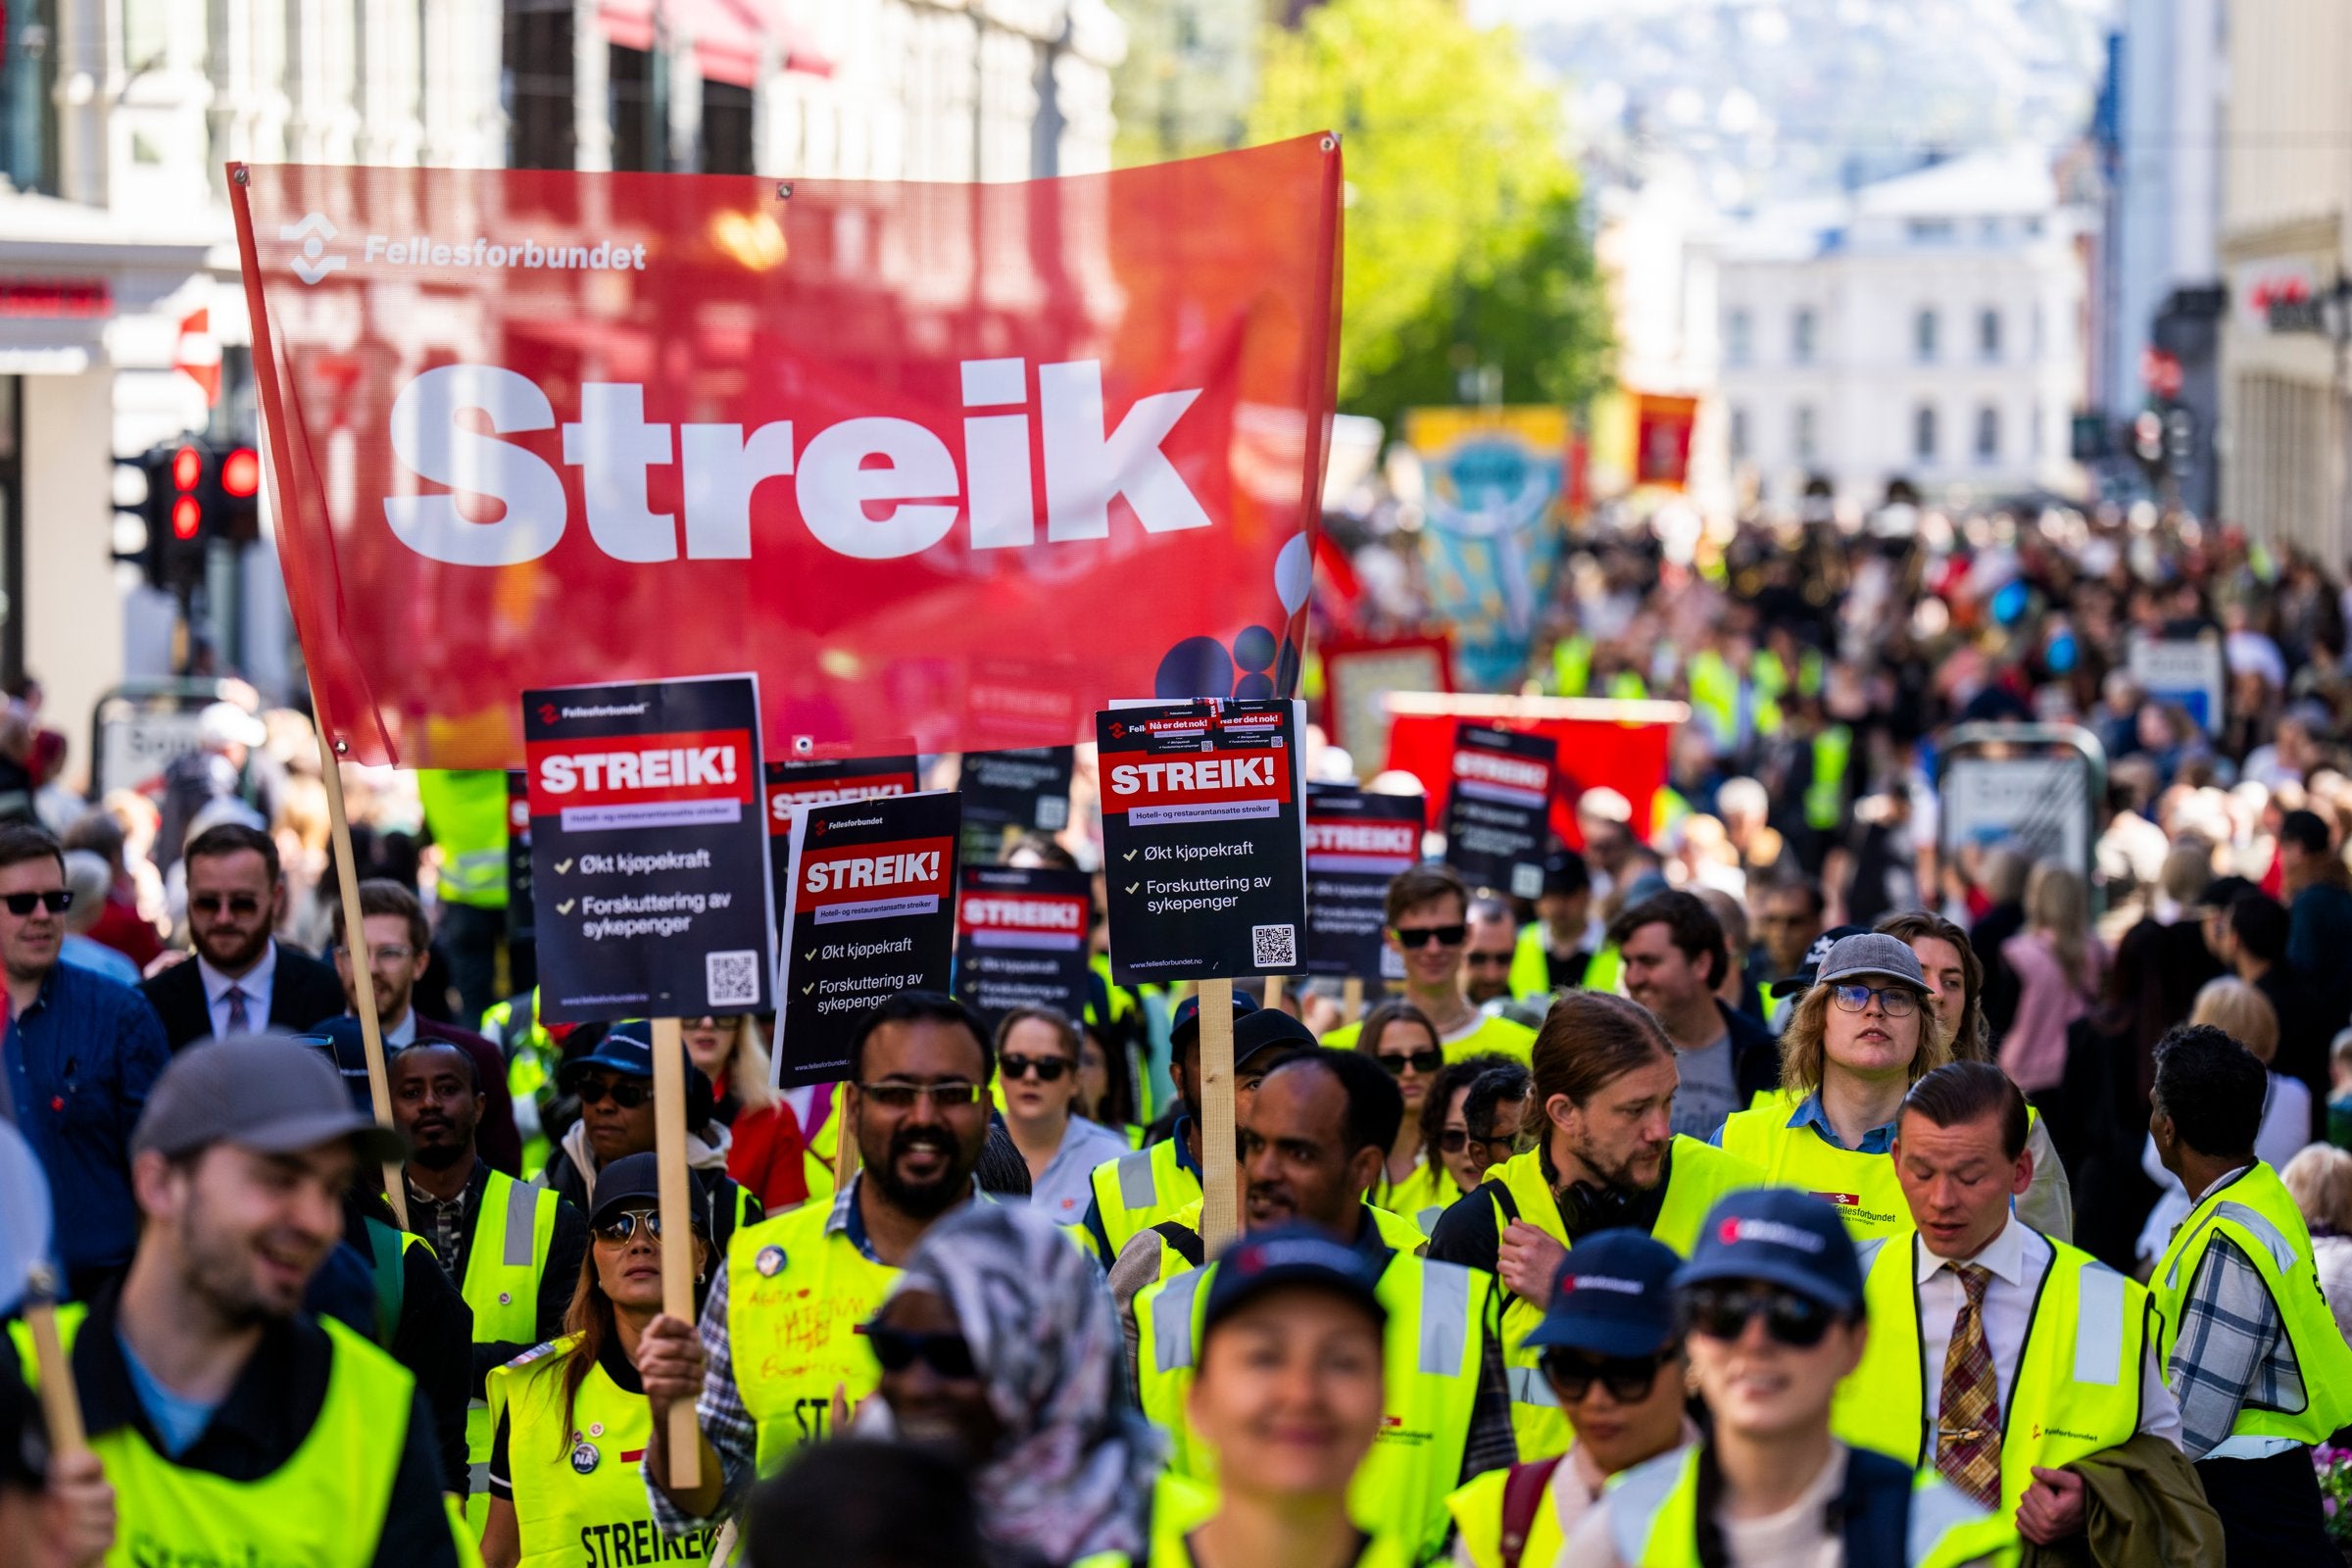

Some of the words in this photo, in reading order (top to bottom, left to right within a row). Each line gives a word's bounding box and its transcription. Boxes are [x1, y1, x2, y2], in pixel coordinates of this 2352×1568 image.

[365, 235, 647, 270] Fellesforbundet
[383, 357, 1212, 566] Streik
[562, 702, 646, 718] Fellesforbundet
[1243, 715, 1257, 724] det
[1258, 714, 1279, 723] nok!
[1150, 721, 1162, 730] Nå
[1173, 720, 1188, 729] det
[1189, 719, 1208, 728] nok!
[540, 745, 737, 795] STREIK!
[1110, 757, 1276, 795] STREIK!
[1136, 810, 1162, 819] Hotell-
[1173, 807, 1241, 818] restaurantansatte
[1241, 805, 1271, 813] streiker
[828, 817, 883, 830] Fellesforbundet
[1144, 846, 1173, 860] Økt
[1175, 841, 1254, 861] kjøpekraft
[579, 854, 615, 874] Økt
[616, 848, 711, 876] kjøpekraft
[806, 851, 941, 893] STREIK!
[1147, 876, 1250, 894] Forskuttering
[1253, 877, 1272, 888] av
[581, 891, 707, 915] Forskuttering
[708, 892, 732, 908] av
[820, 909, 842, 918] Hotell-
[842, 908, 851, 917] og
[851, 903, 906, 914] restaurantansatte
[906, 901, 932, 909] streiker
[1147, 896, 1239, 914] sykepenger
[582, 915, 693, 941] sykepenger
[821, 945, 846, 960] Økt
[847, 938, 912, 960] kjøpekraft
[1129, 958, 1203, 969] www.fellesforbundet.no
[819, 973, 905, 995] Forskuttering
[906, 973, 924, 985] av
[795, 1058, 851, 1071] www.fellesforbundet.
